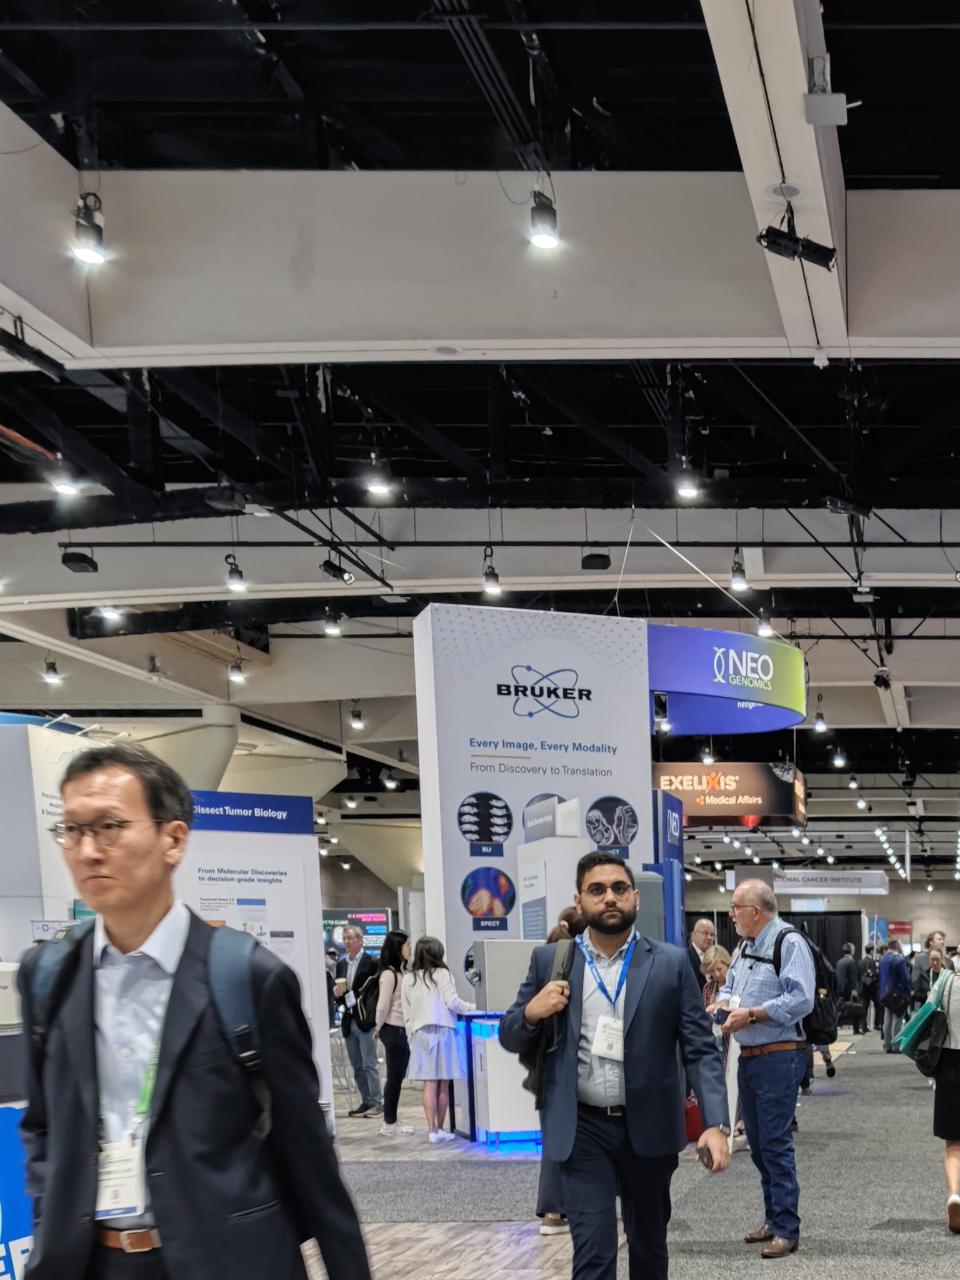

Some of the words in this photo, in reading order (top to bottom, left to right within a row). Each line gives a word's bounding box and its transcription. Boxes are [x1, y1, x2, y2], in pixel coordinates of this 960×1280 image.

[728, 649, 774, 681] NEO
[728, 674, 773, 691] GENOMICS
[496, 684, 593, 701] BRUKER
[469, 738, 499, 750] Every
[502, 739, 538, 751] Image,
[540, 741, 570, 752] Every
[572, 742, 618, 756] Modality
[470, 762, 496, 773] From
[499, 763, 548, 776] Discovery
[550, 765, 560, 775] to
[561, 765, 613, 777] Translation
[705, 795, 736, 806] Medical
[737, 795, 763, 805] Affairs
[223, 806, 253, 816] Tumor
[254, 808, 288, 820] Biology
[251, 869, 288, 877] Discoveries
[829, 876, 863, 884] INSTITUTE
[207, 876, 256, 884] decision-grade
[256, 877, 283, 885] insights
[480, 920, 501, 928] SPECT
